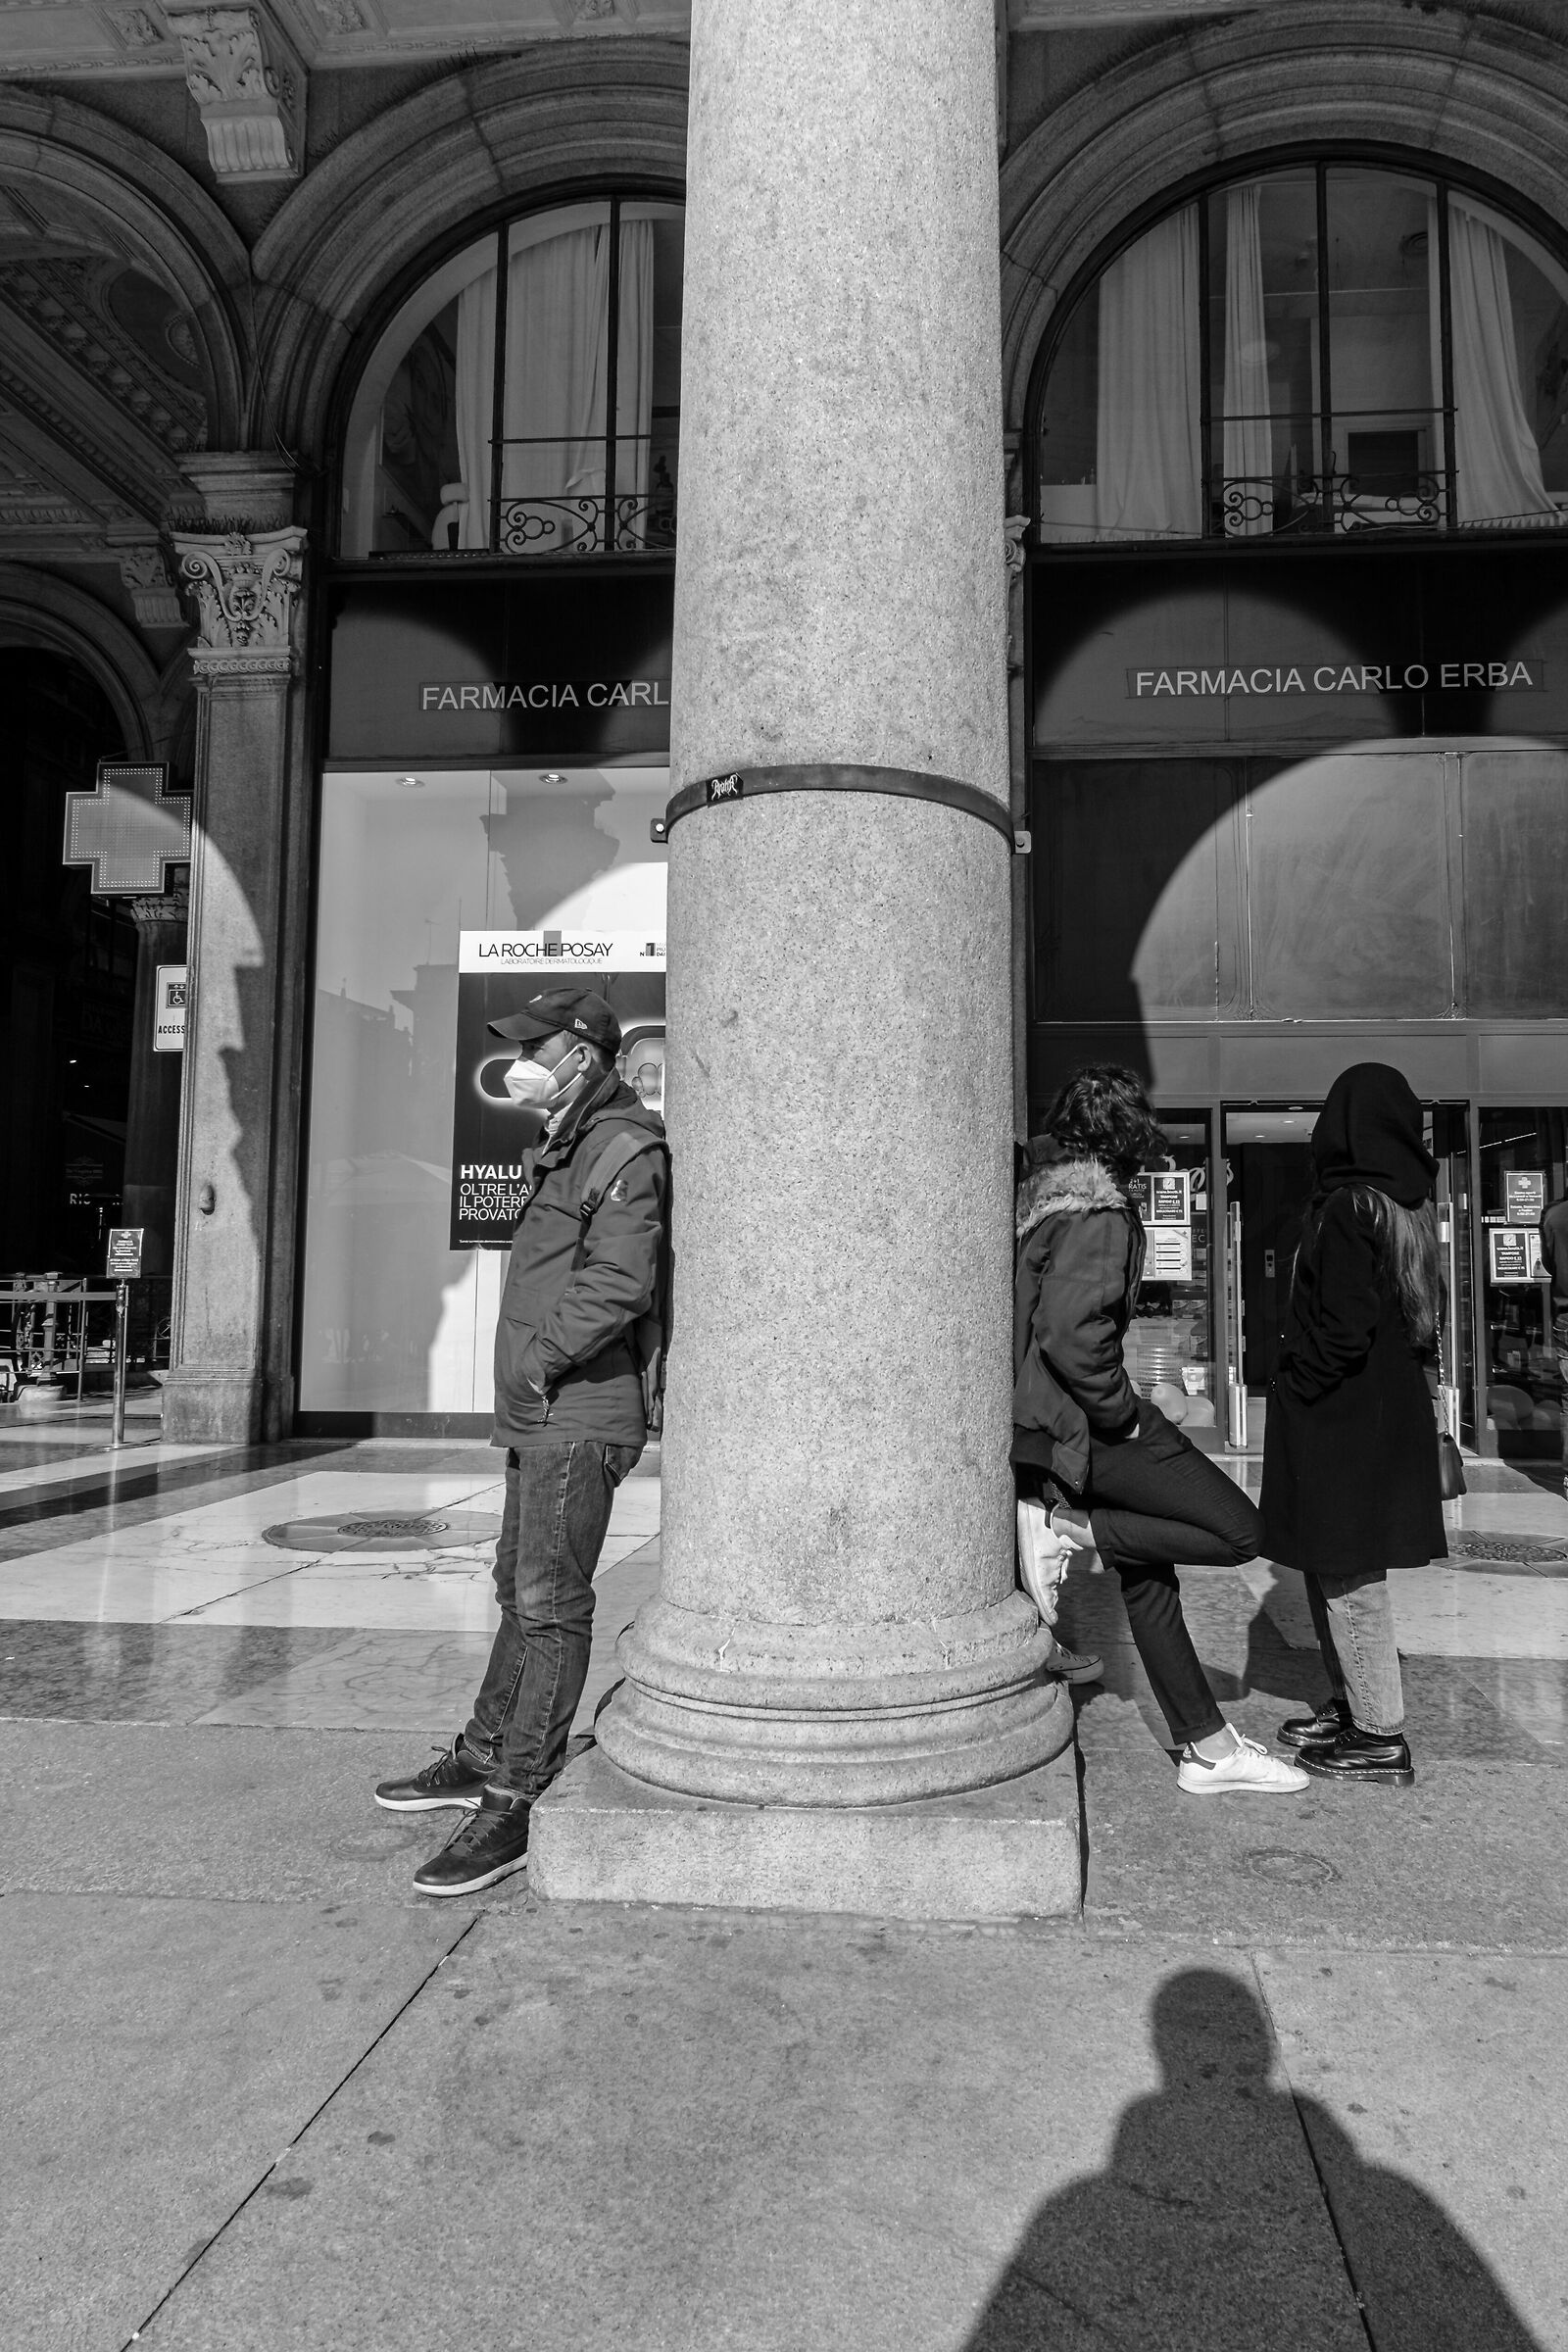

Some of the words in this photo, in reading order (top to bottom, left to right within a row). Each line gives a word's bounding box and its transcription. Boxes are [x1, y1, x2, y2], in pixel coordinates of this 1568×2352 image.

[1136, 667, 1305, 697] FARMACIA
[1313, 664, 1430, 693] CARLO
[1441, 661, 1534, 688] ERBA
[422, 685, 579, 710] FARMACIA
[587, 682, 670, 708] CARL
[479, 943, 499, 957] LA
[502, 943, 558, 957] ROCHE
[561, 942, 613, 957] POSAY
[158, 1025, 185, 1034] ACCESS
[461, 1164, 522, 1180] HYALU
[460, 1183, 507, 1196] OLTRE
[509, 1183, 532, 1196] L'A
[460, 1196, 471, 1208] IL
